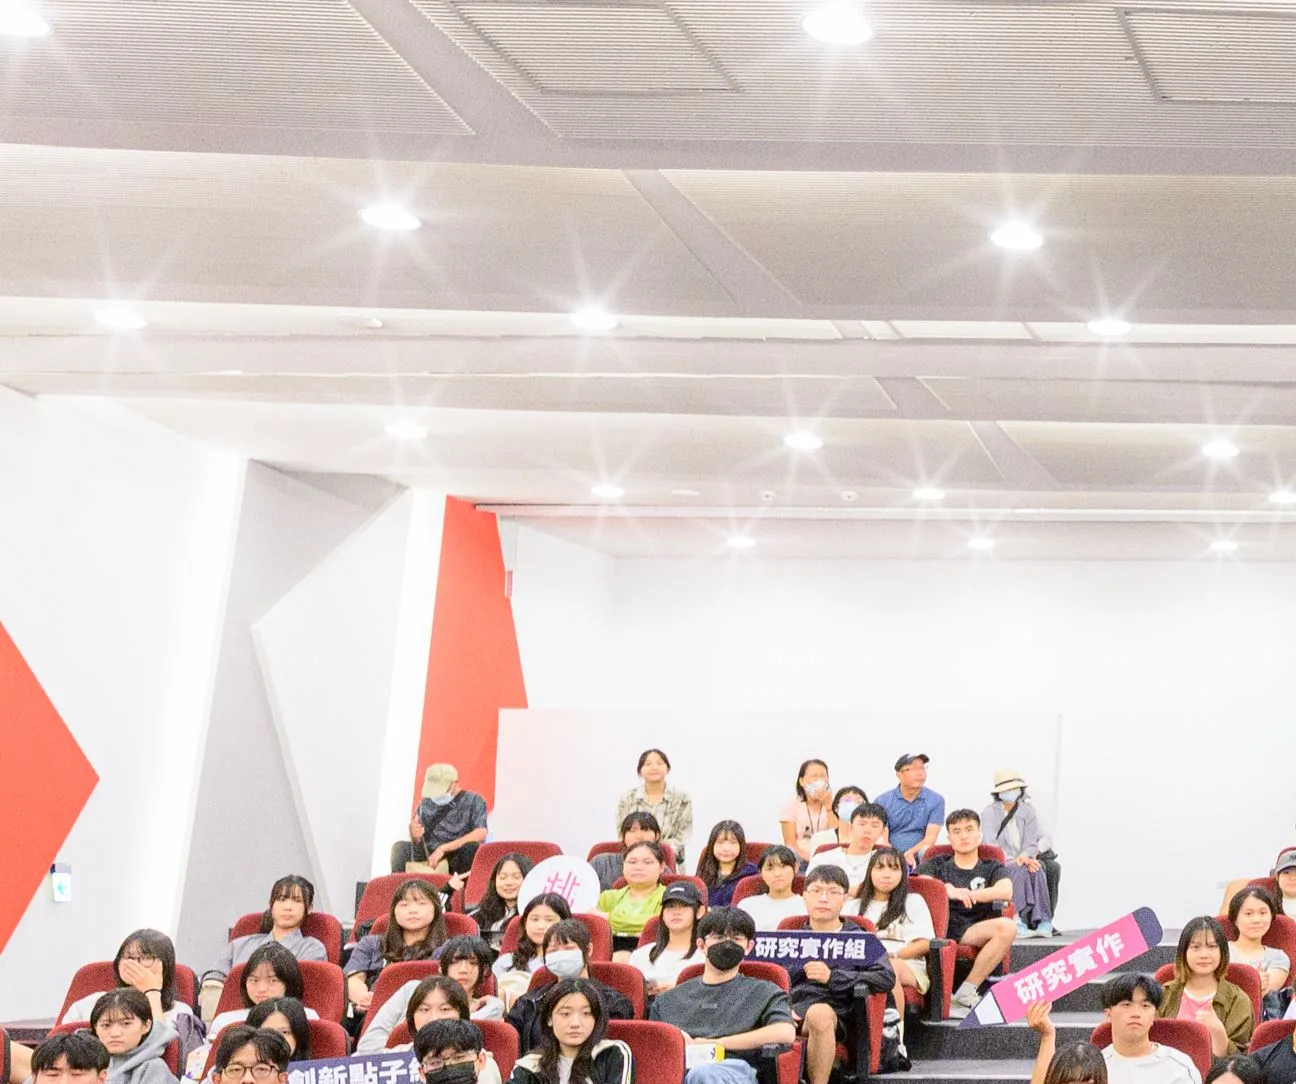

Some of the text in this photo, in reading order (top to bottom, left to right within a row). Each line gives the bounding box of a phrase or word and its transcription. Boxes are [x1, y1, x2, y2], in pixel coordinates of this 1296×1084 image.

[755, 935, 866, 961] 研究實作組
[1013, 931, 1125, 1003] 研究實作
